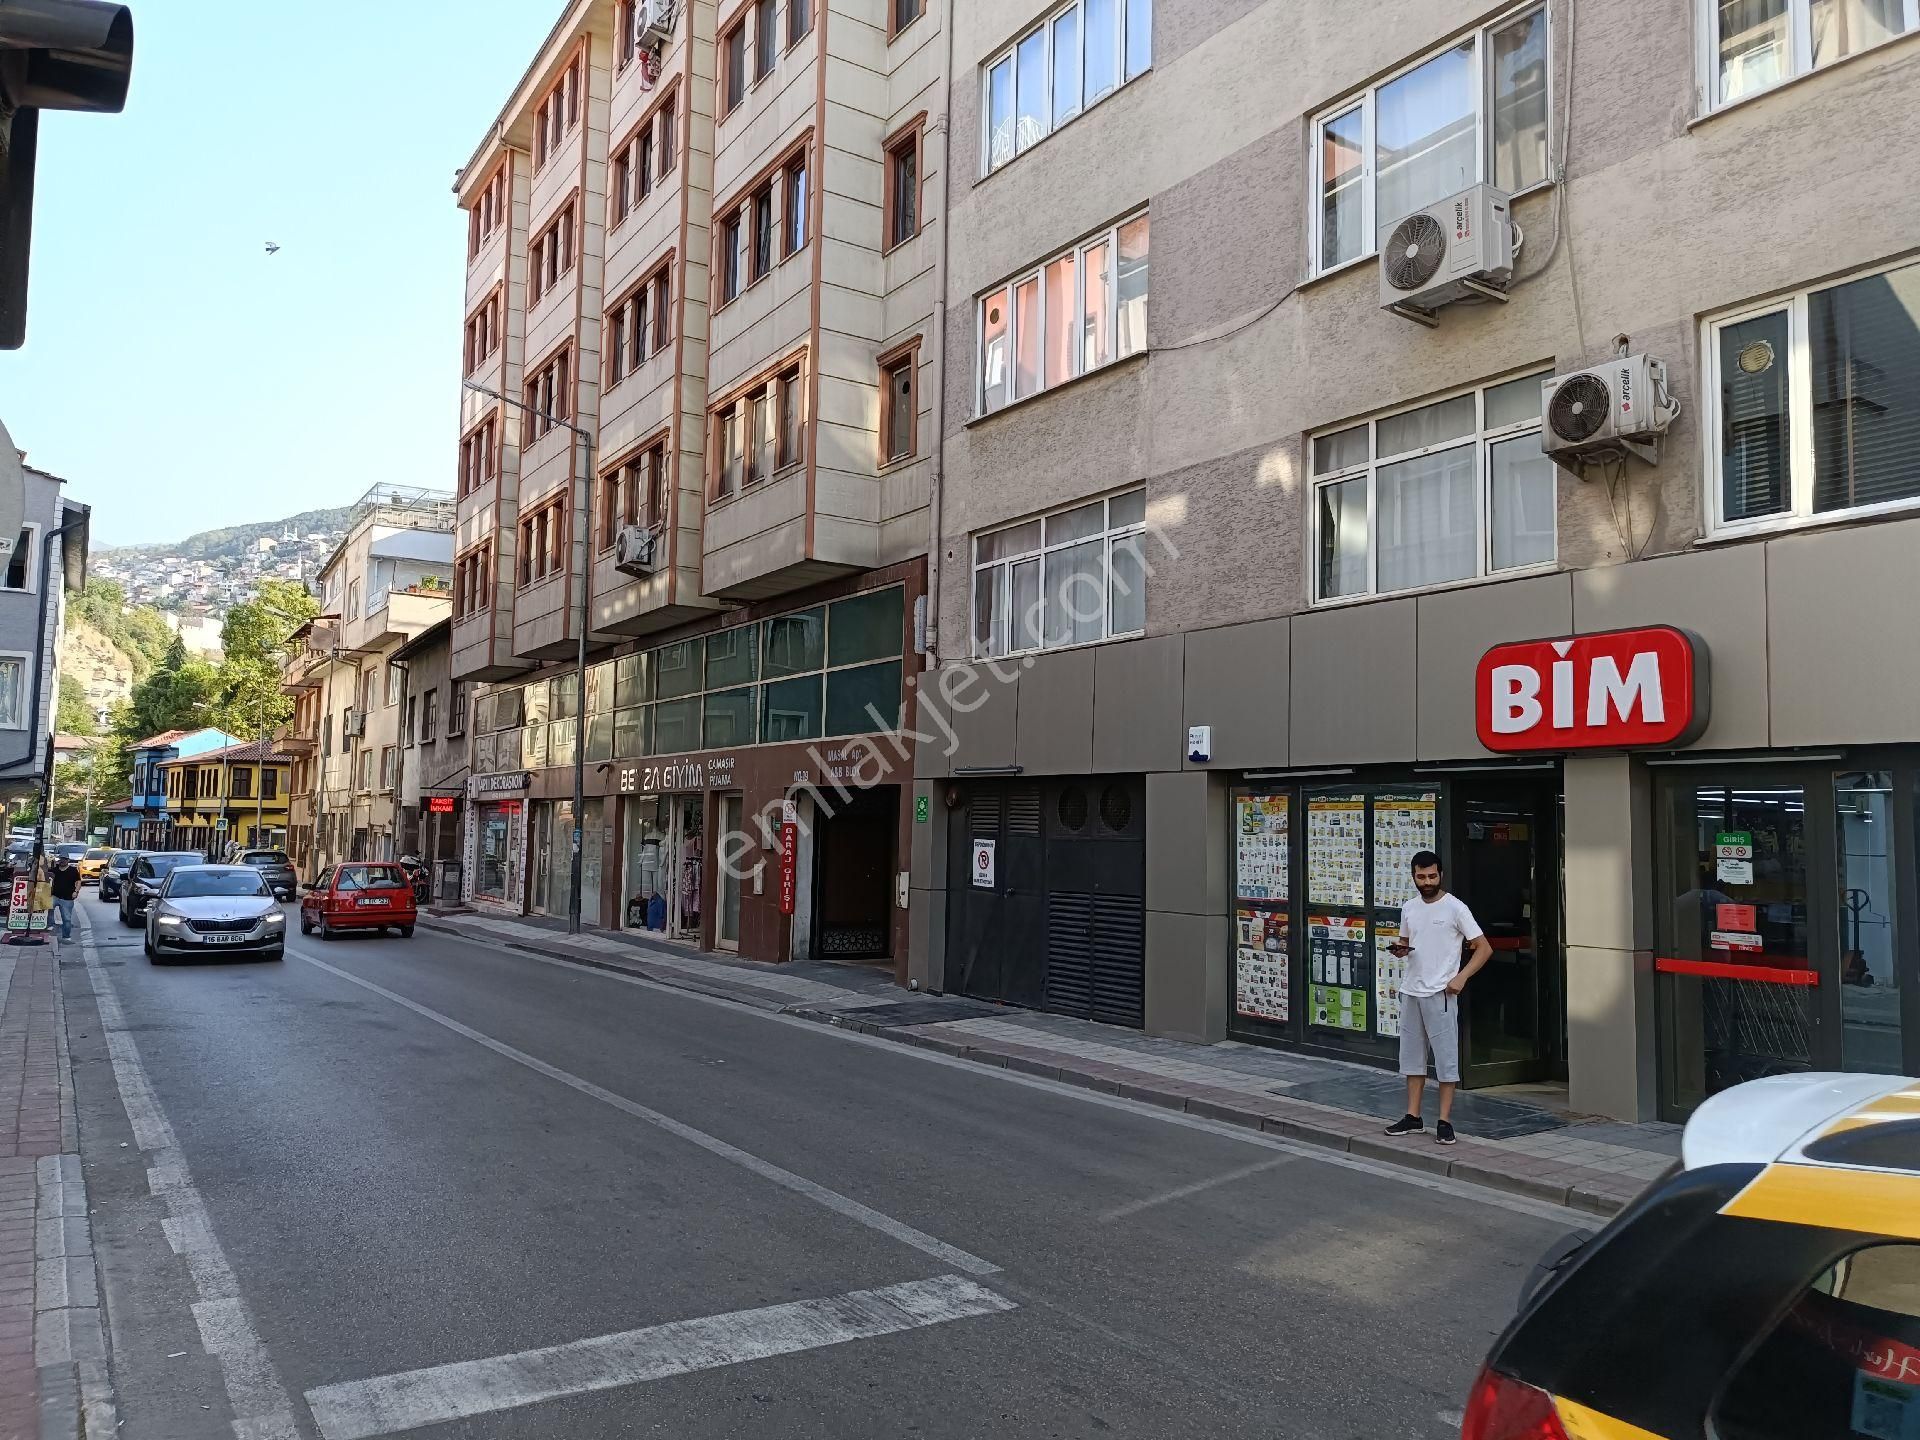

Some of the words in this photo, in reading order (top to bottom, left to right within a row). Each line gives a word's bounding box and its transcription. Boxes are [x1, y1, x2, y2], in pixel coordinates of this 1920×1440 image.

[1455, 201, 1465, 231] arçelik
[1620, 368, 1632, 401] arçelik
[1491, 640, 1666, 734] BİM
[1723, 835, 1745, 845] GİRİŞ
